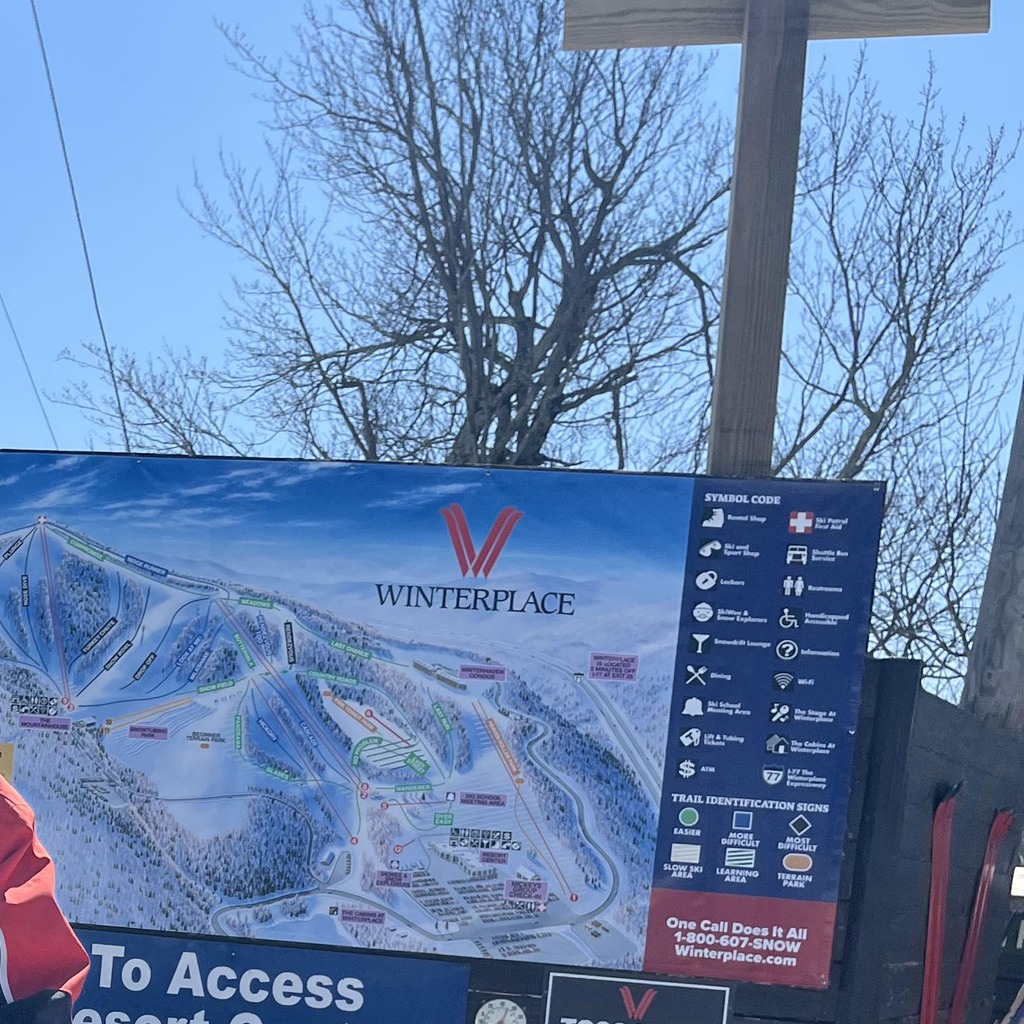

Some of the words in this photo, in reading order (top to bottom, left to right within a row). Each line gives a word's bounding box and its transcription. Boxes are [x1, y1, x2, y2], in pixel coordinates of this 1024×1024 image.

[704, 493, 750, 503] SYMBOL
[751, 495, 781, 505] CODE
[750, 515, 767, 523] Shop
[743, 550, 760, 558] Shop
[375, 583, 576, 616] WINTERPLACE
[804, 612, 850, 621] Handicapped
[747, 640, 771, 648] Lounge
[801, 648, 840, 657] Information
[710, 672, 731, 680] Dining
[707, 707, 733, 715] Meeting
[808, 709, 827, 718] Stage
[794, 714, 833, 723] Winterplace
[723, 734, 744, 743] Tubing
[791, 746, 830, 755] Winterplace
[787, 774, 827, 783] Winterplace
[786, 780, 827, 790] Expressway
[671, 793, 704, 804] TRAIL
[705, 795, 795, 811] IDENTIFICATION
[796, 803, 830, 813] SIGNS
[673, 828, 701, 837] EASIER
[728, 832, 754, 840] MORE
[721, 838, 760, 848] DIFFICULT
[785, 836, 811, 845] MOST
[778, 842, 817, 852] DIFFICULT
[663, 863, 689, 873] SLOW
[716, 867, 760, 878] LEARNING
[671, 871, 693, 879] AREA
[724, 875, 747, 883] AREA
[777, 872, 813, 882] TERRAIN
[783, 879, 805, 888] PARK
[666, 917, 696, 930] One
[700, 919, 728, 933] Call
[732, 922, 769, 937] Does
[772, 926, 783, 938] It
[786, 928, 808, 940] All
[674, 931, 801, 953] 1-800-607-SNOW
[675, 944, 797, 966] Winterplace.com
[91, 943, 151, 992] To
[167, 952, 364, 1012] Access
